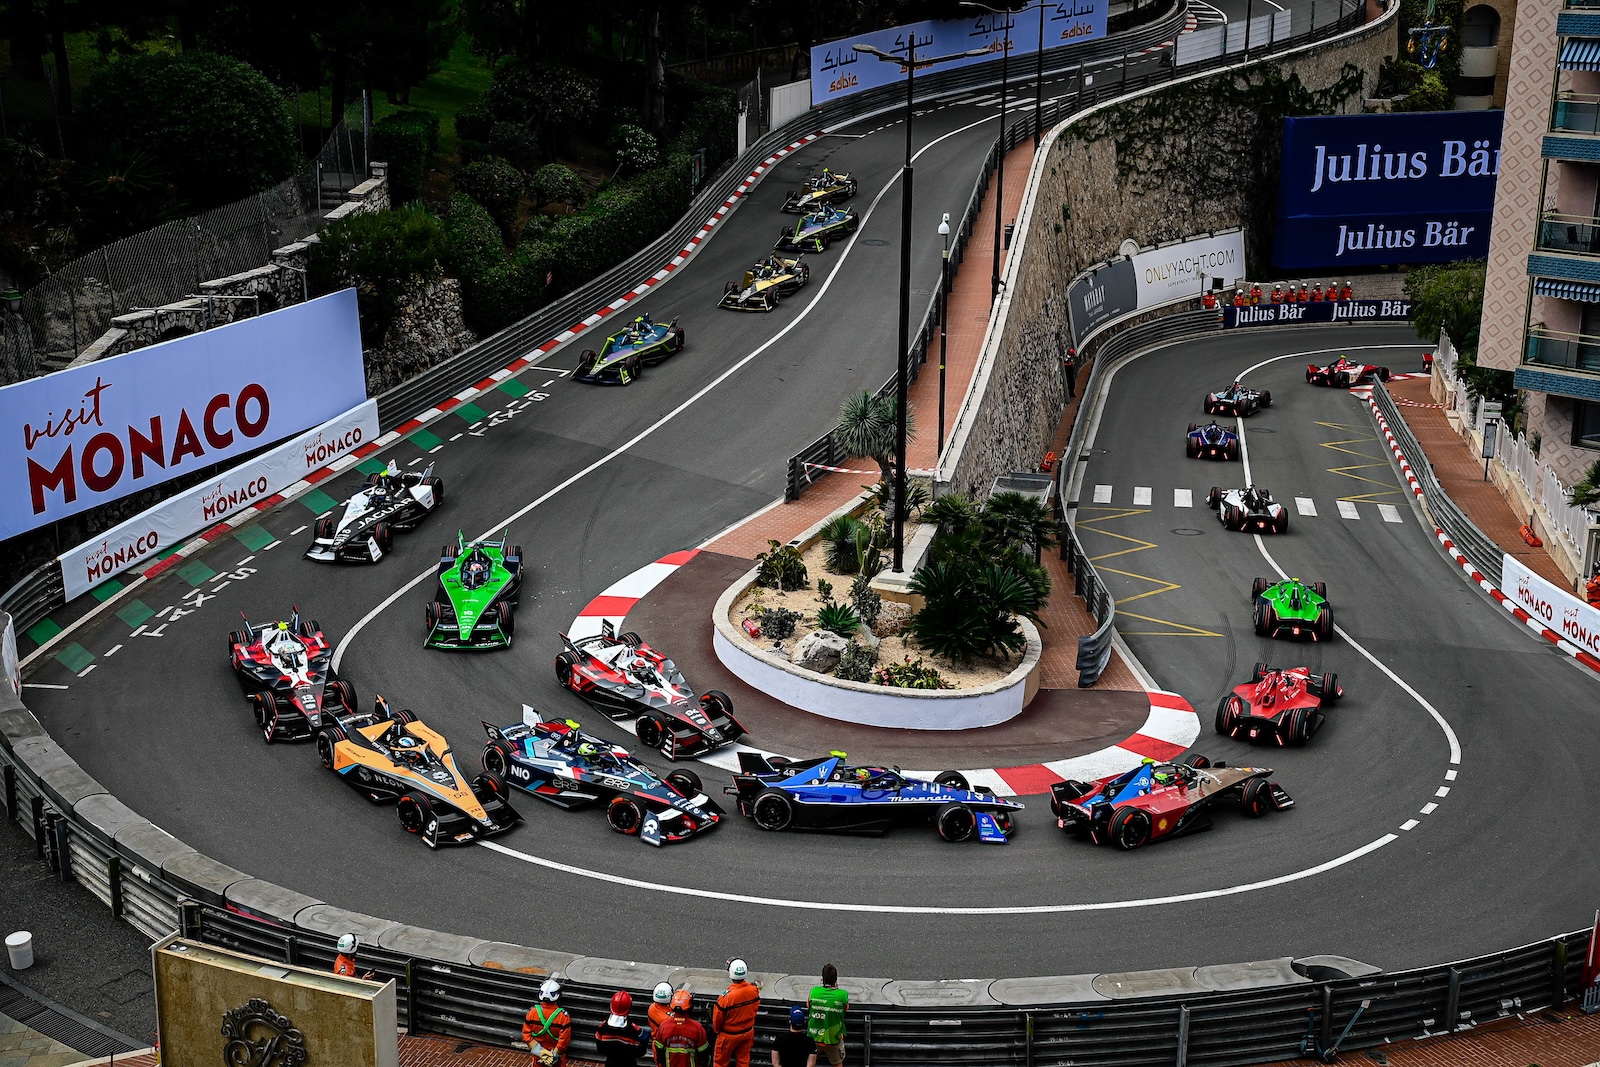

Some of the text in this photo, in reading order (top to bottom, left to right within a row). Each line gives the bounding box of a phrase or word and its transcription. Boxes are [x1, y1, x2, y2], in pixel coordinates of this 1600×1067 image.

[980, 37, 1014, 54] sabc
[1060, 21, 1093, 40] sabic
[828, 71, 858, 93] sabic
[1311, 138, 1500, 192] Julius Bär
[1336, 220, 1475, 256] Julius Bär
[1145, 249, 1235, 285] ONLYYACHT.COM
[1235, 303, 1306, 327] Julius Bär
[1332, 299, 1411, 321] Julius Bär
[24, 376, 113, 451] visit
[468, 392, 550, 437] TAXIS
[26, 383, 270, 515] MONACO
[304, 431, 325, 456] visit
[305, 427, 362, 468] MONACO
[202, 483, 224, 506] visit
[203, 476, 268, 521] MONACO
[358, 497, 415, 530] JAGUAR
[85, 539, 109, 564] visit
[87, 530, 159, 583] MONACO
[142, 565, 257, 638] TAXIS
[1518, 586, 1553, 621] MONACO
[1563, 617, 1600, 653] MONAC
[373, 774, 405, 790] NEOM
[510, 764, 531, 781] NIO
[887, 794, 956, 803] Maserati
